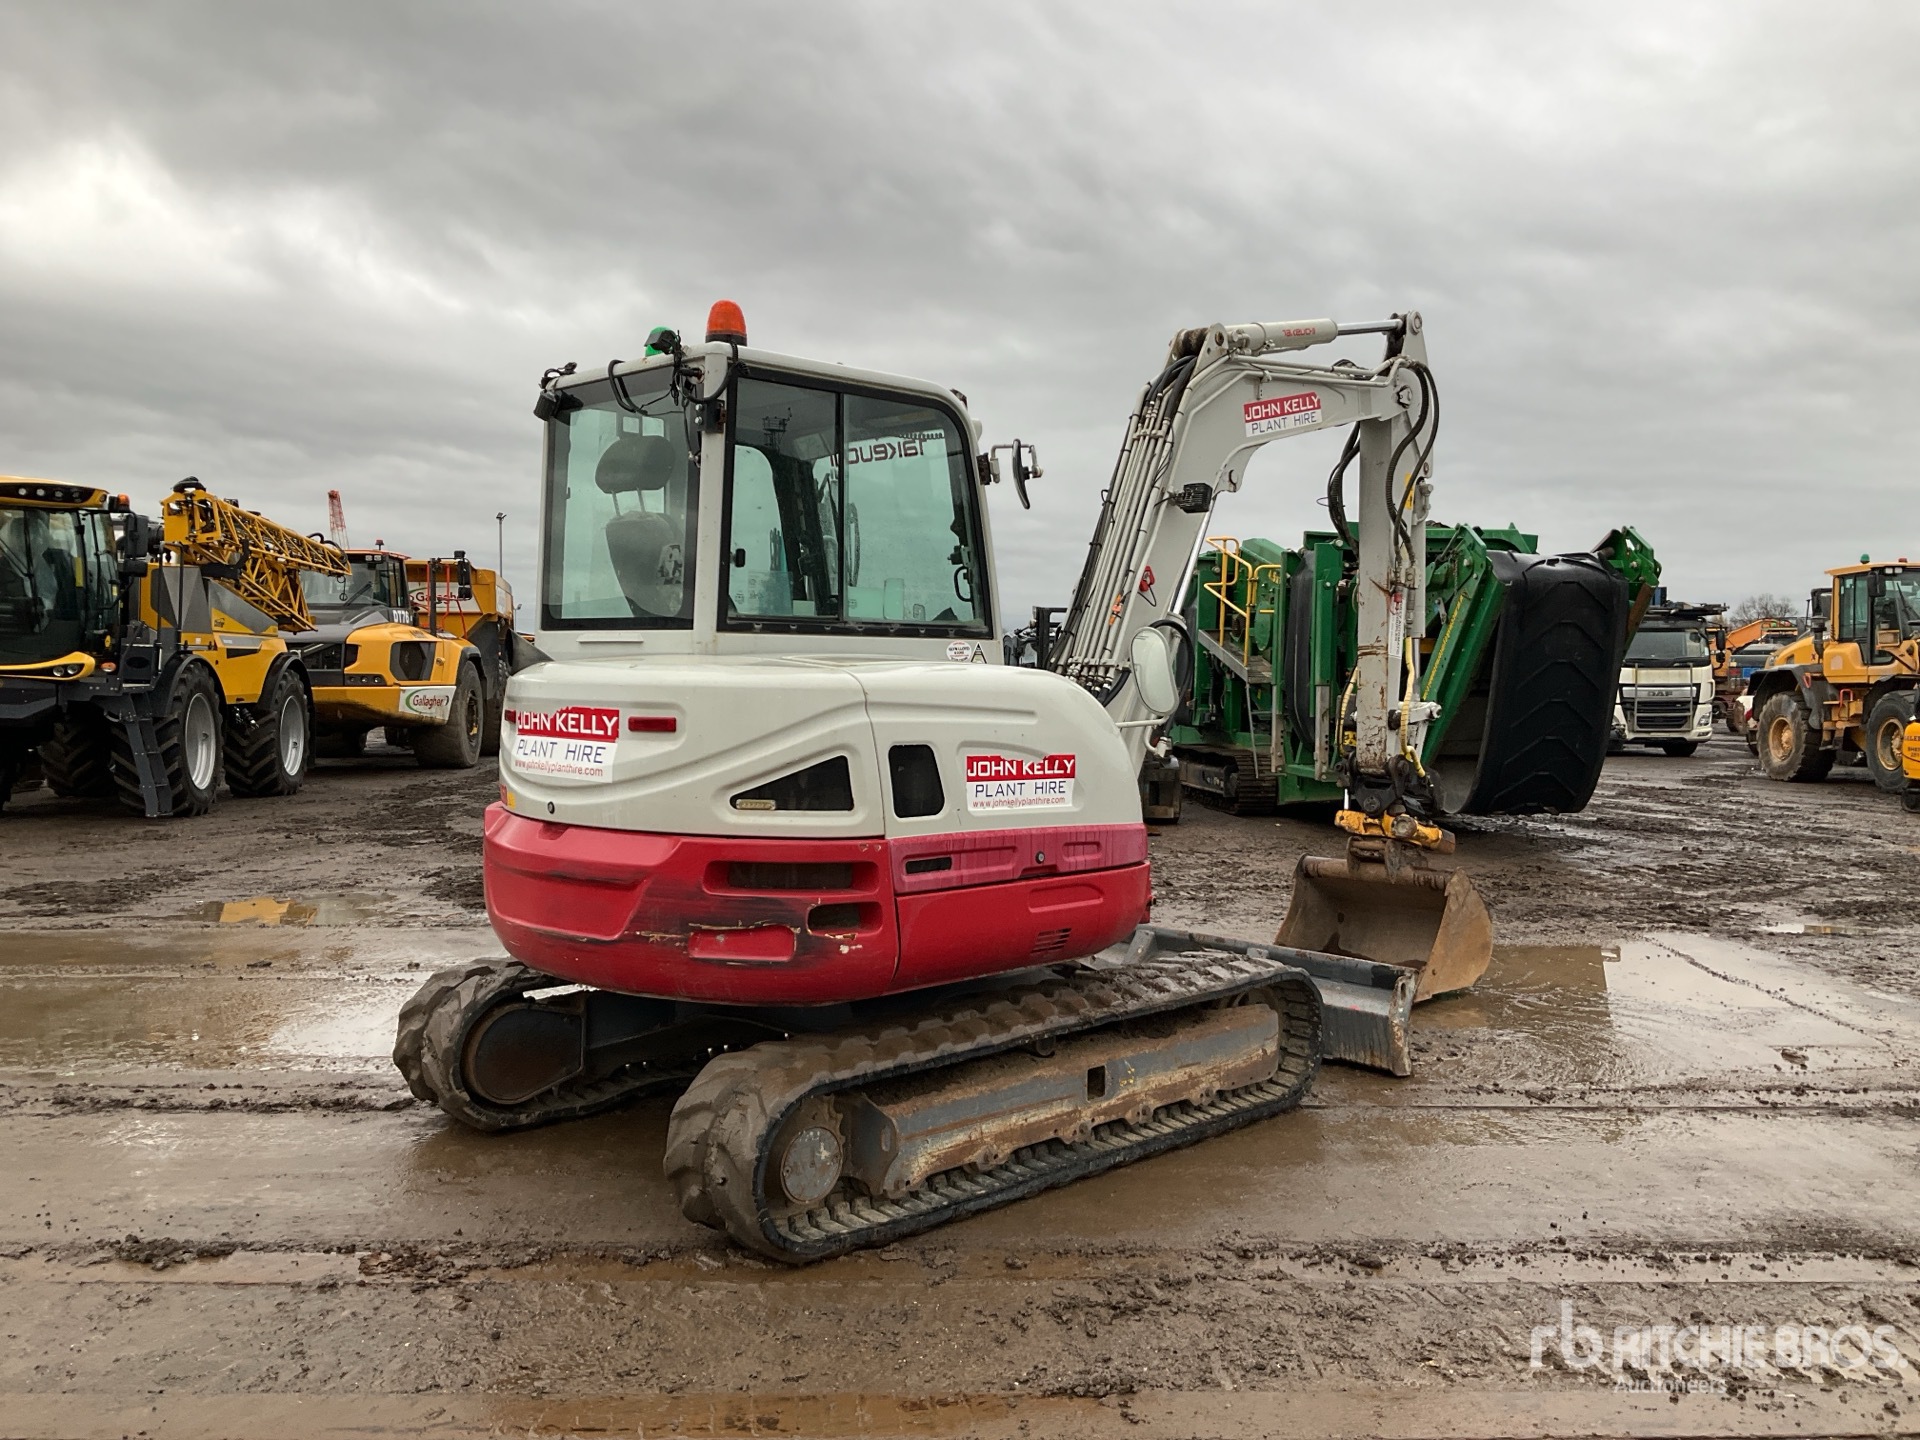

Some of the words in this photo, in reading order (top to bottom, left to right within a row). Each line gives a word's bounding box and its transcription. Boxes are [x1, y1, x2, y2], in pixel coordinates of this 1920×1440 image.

[1245, 402, 1281, 421] JOHN
[1283, 394, 1321, 412] KELLY
[1251, 417, 1287, 434] PLANT
[1293, 411, 1317, 426] HIRE
[412, 694, 444, 709] Gallagher
[517, 711, 551, 731] JOHN
[556, 713, 618, 736] KELLY
[516, 739, 558, 758] PLANT
[565, 743, 606, 764] HIRE
[514, 759, 604, 777] www.johnkellyplanthire.com
[967, 760, 1017, 777] JOHN
[1022, 759, 1075, 775] KELLY
[975, 782, 1026, 798] PLANT
[1034, 780, 1067, 795] HIRE
[972, 796, 1066, 809] www.johnkellyplanthire.com
